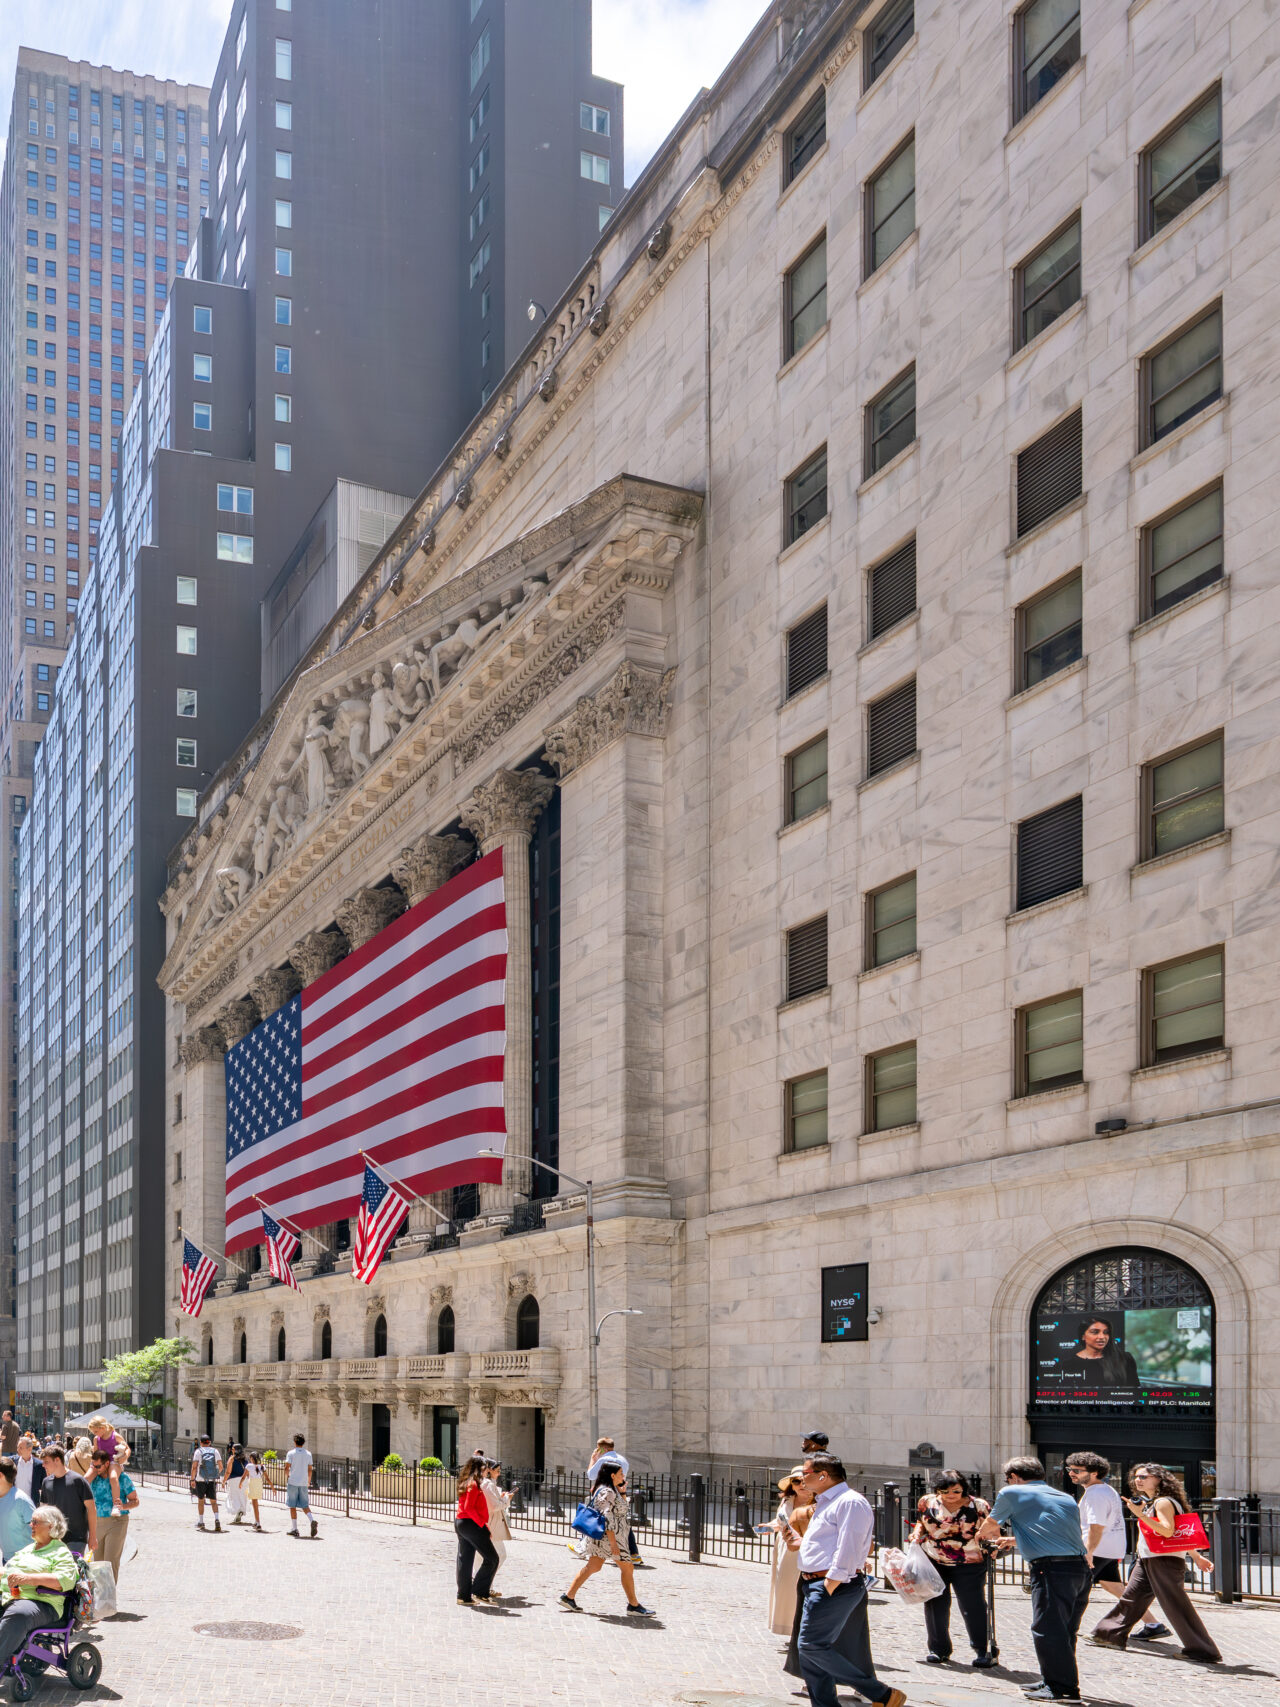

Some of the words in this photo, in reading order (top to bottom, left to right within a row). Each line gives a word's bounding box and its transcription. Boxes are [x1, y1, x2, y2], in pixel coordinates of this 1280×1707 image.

[260, 925, 277, 947] NEW
[281, 900, 306, 929] YORK
[312, 863, 344, 903] STOCK
[351, 796, 415, 869] EXCHANGE
